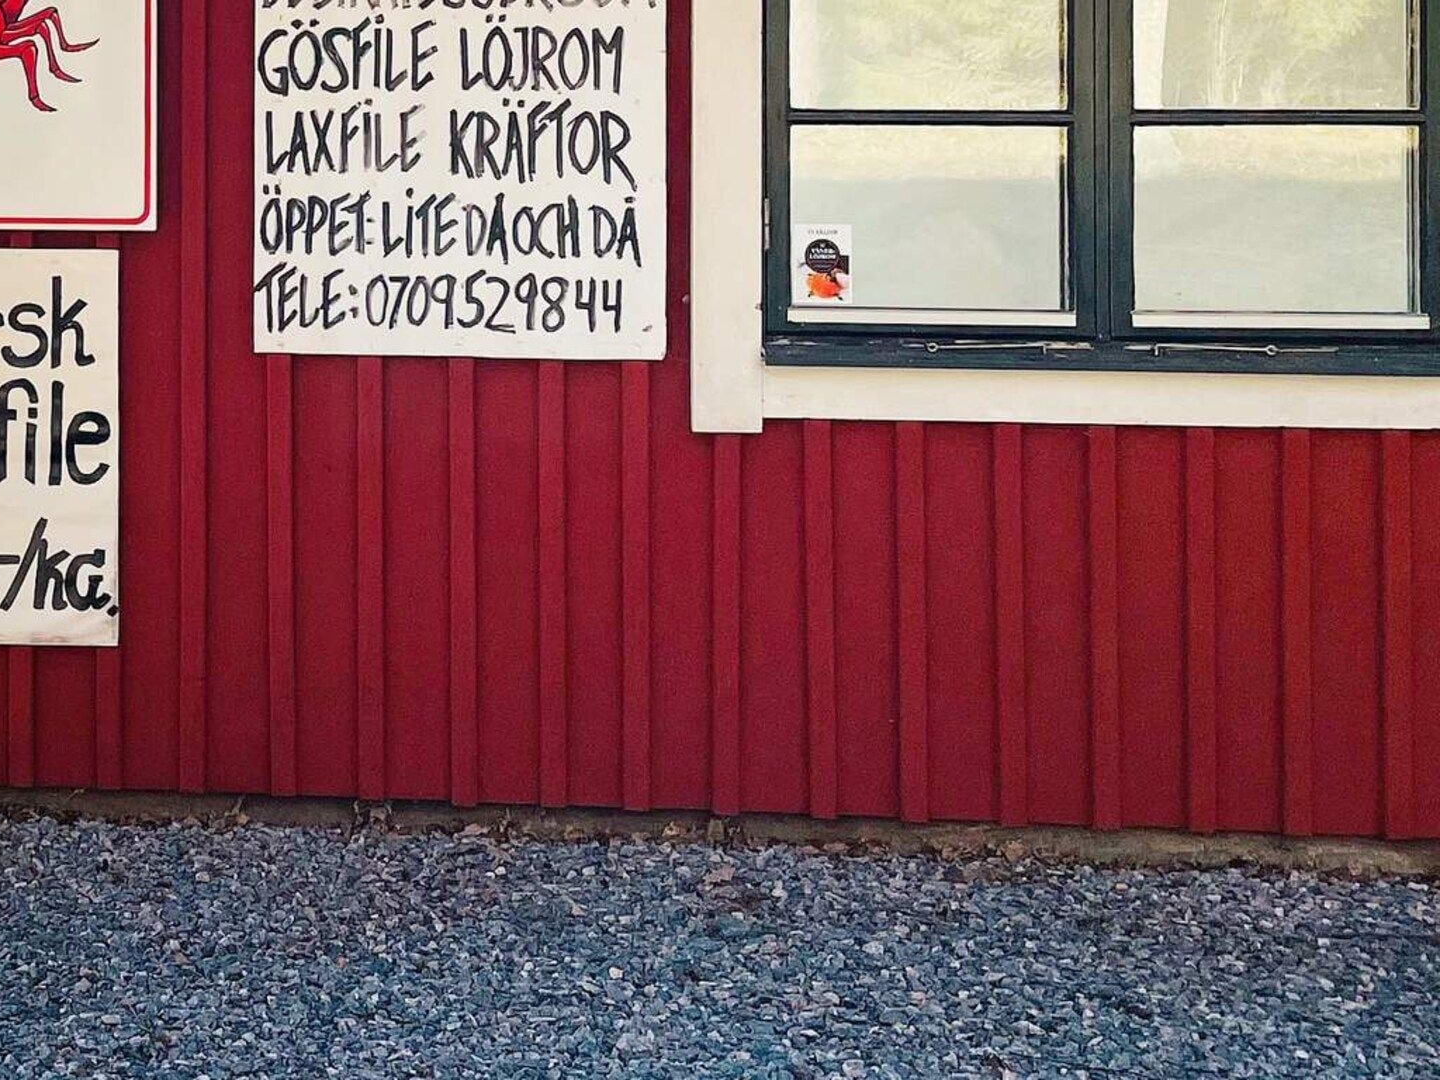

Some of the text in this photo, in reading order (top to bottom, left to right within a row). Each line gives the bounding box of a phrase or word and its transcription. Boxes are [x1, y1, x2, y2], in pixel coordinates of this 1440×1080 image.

[459, 13, 625, 96] LÖJROM
[448, 97, 639, 192] KRÄFTOR
[253, 261, 624, 335] TELE: 0709529844
